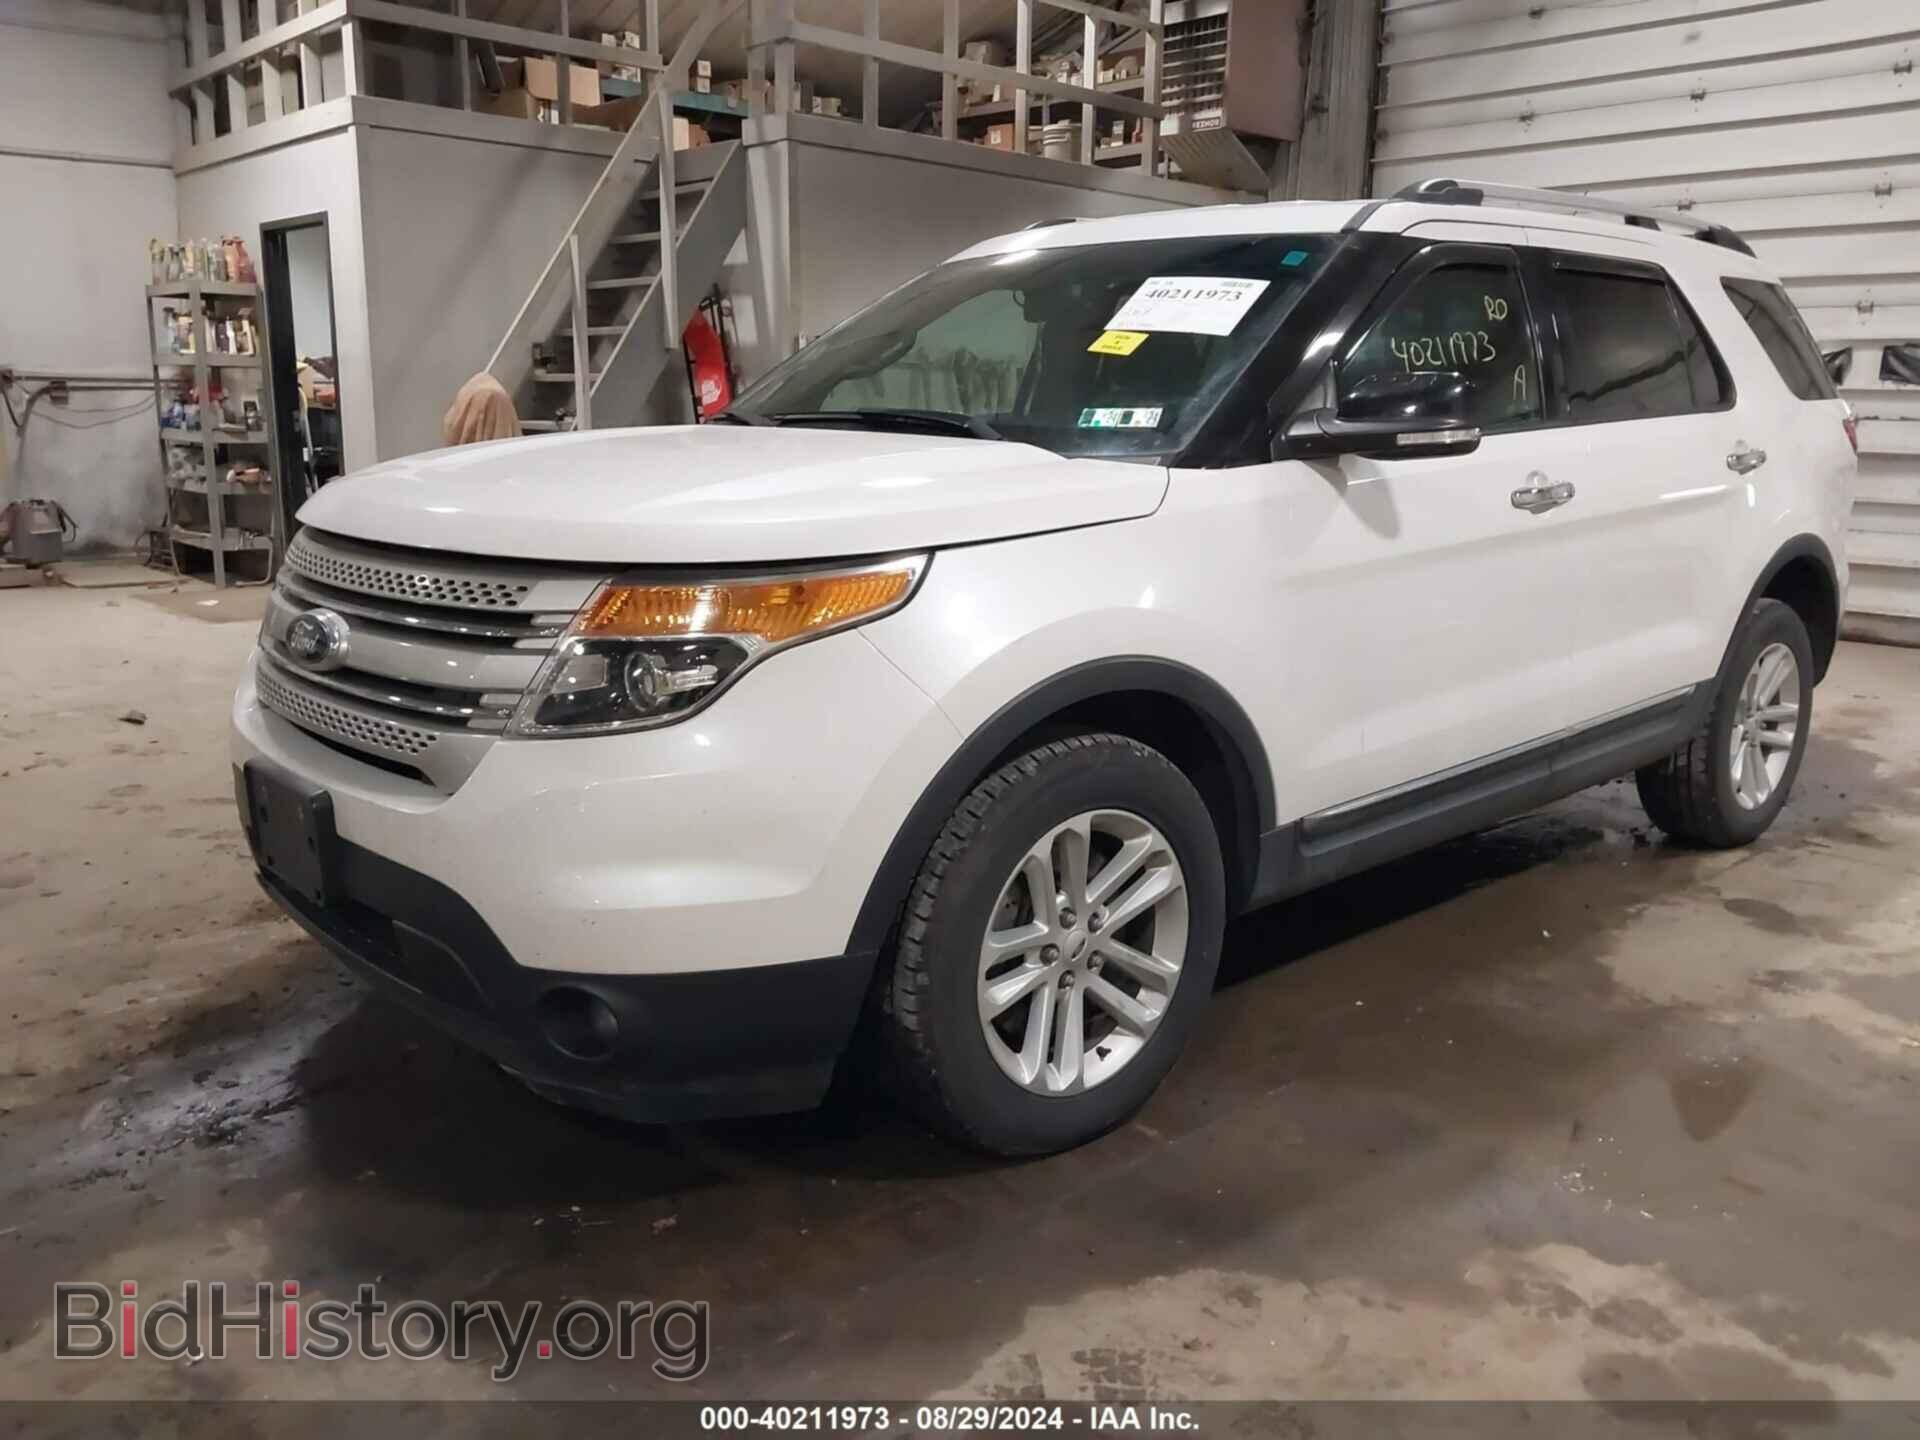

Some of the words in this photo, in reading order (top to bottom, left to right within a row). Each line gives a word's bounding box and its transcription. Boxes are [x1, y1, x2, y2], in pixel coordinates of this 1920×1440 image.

[1145, 288, 1244, 302] 40211973
[1391, 331, 1496, 373] 40211973
[1512, 364, 1527, 400] A
